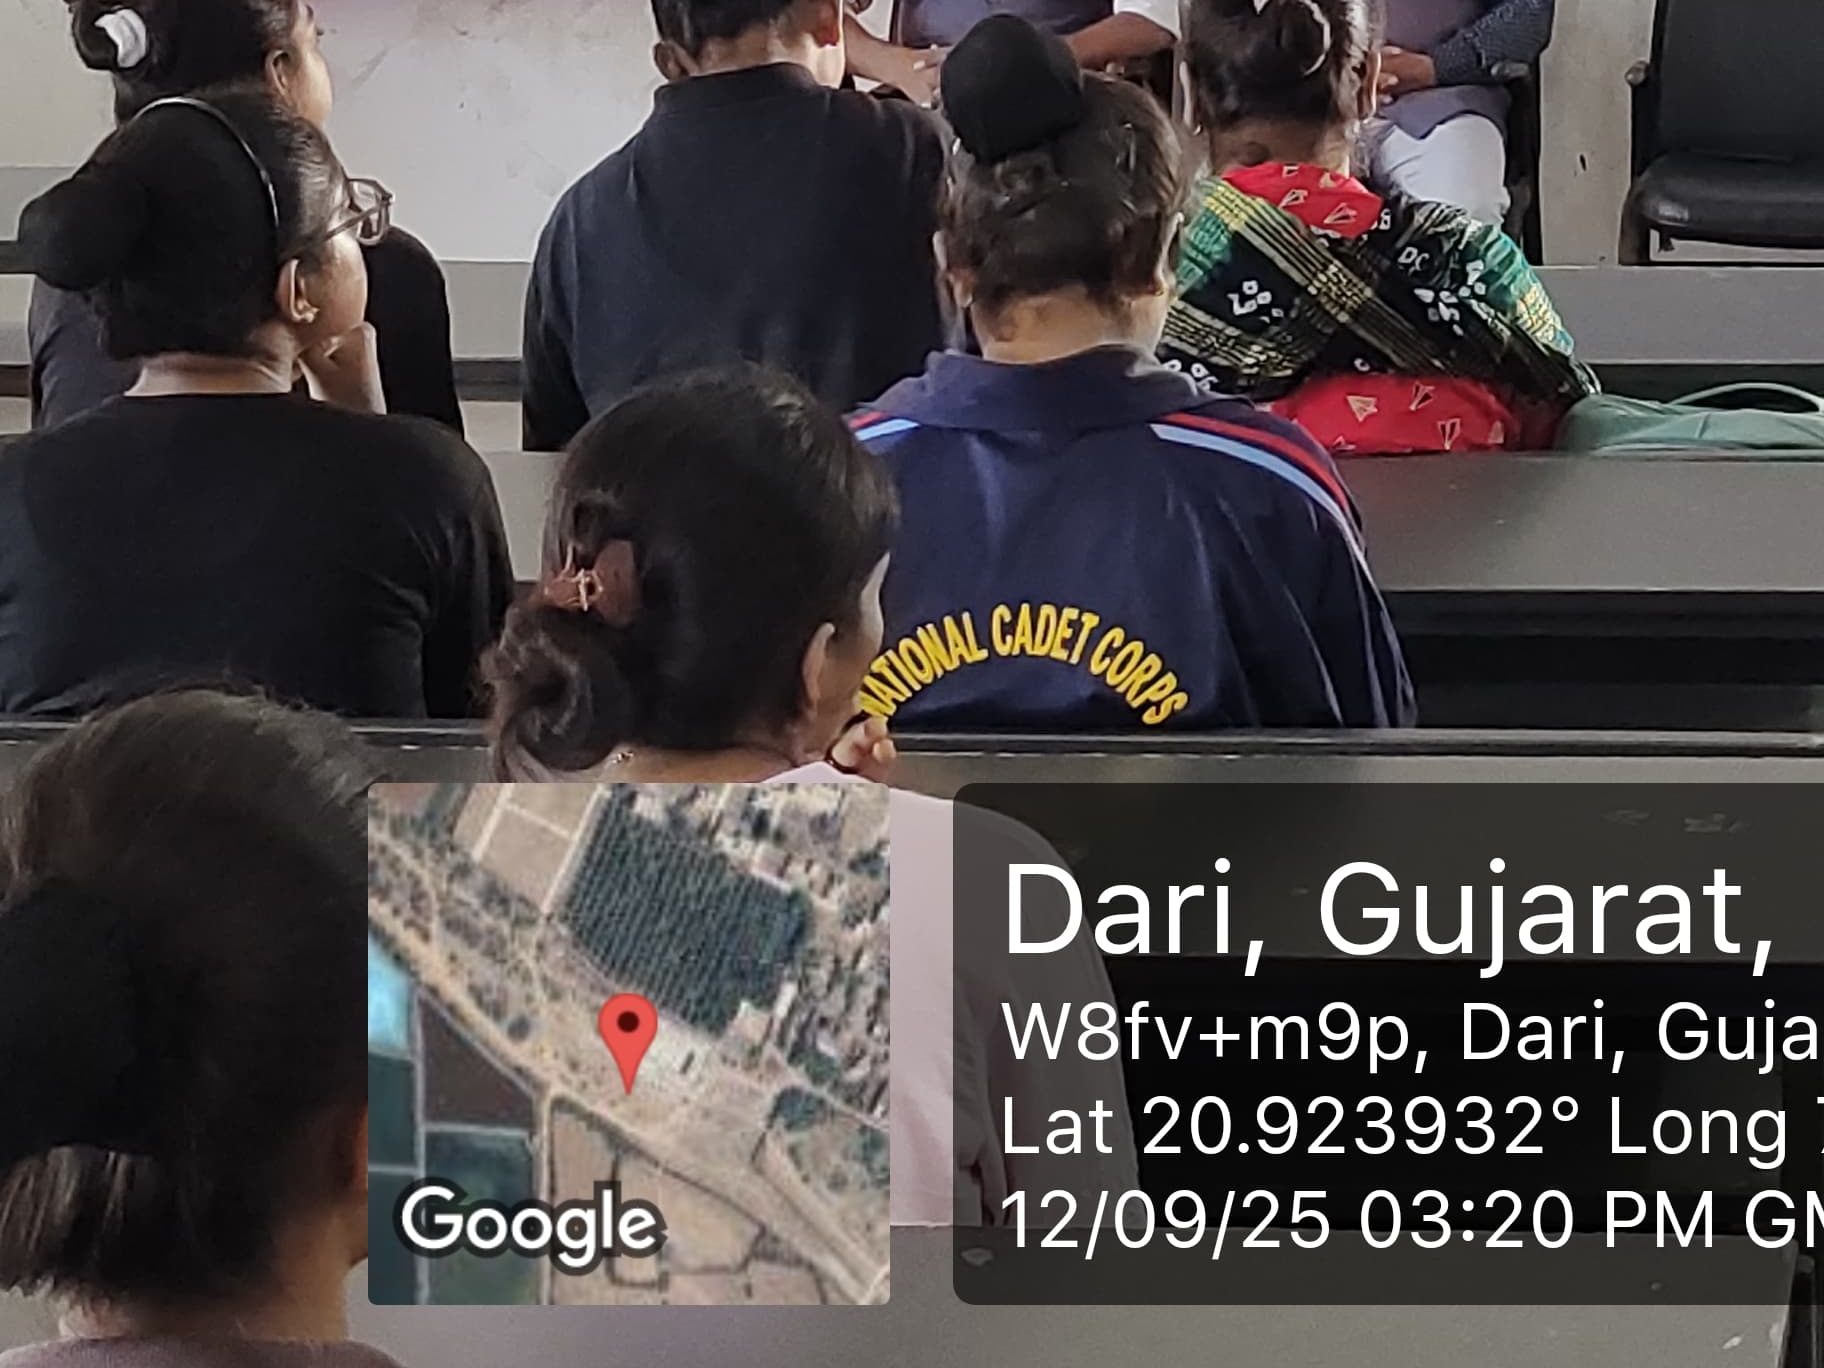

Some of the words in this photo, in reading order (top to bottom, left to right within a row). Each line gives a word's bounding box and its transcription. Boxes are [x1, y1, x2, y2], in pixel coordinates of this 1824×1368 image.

[859, 610, 989, 720] NATIONAL
[991, 602, 1100, 665] CADET
[1089, 626, 1189, 725] CORPS
